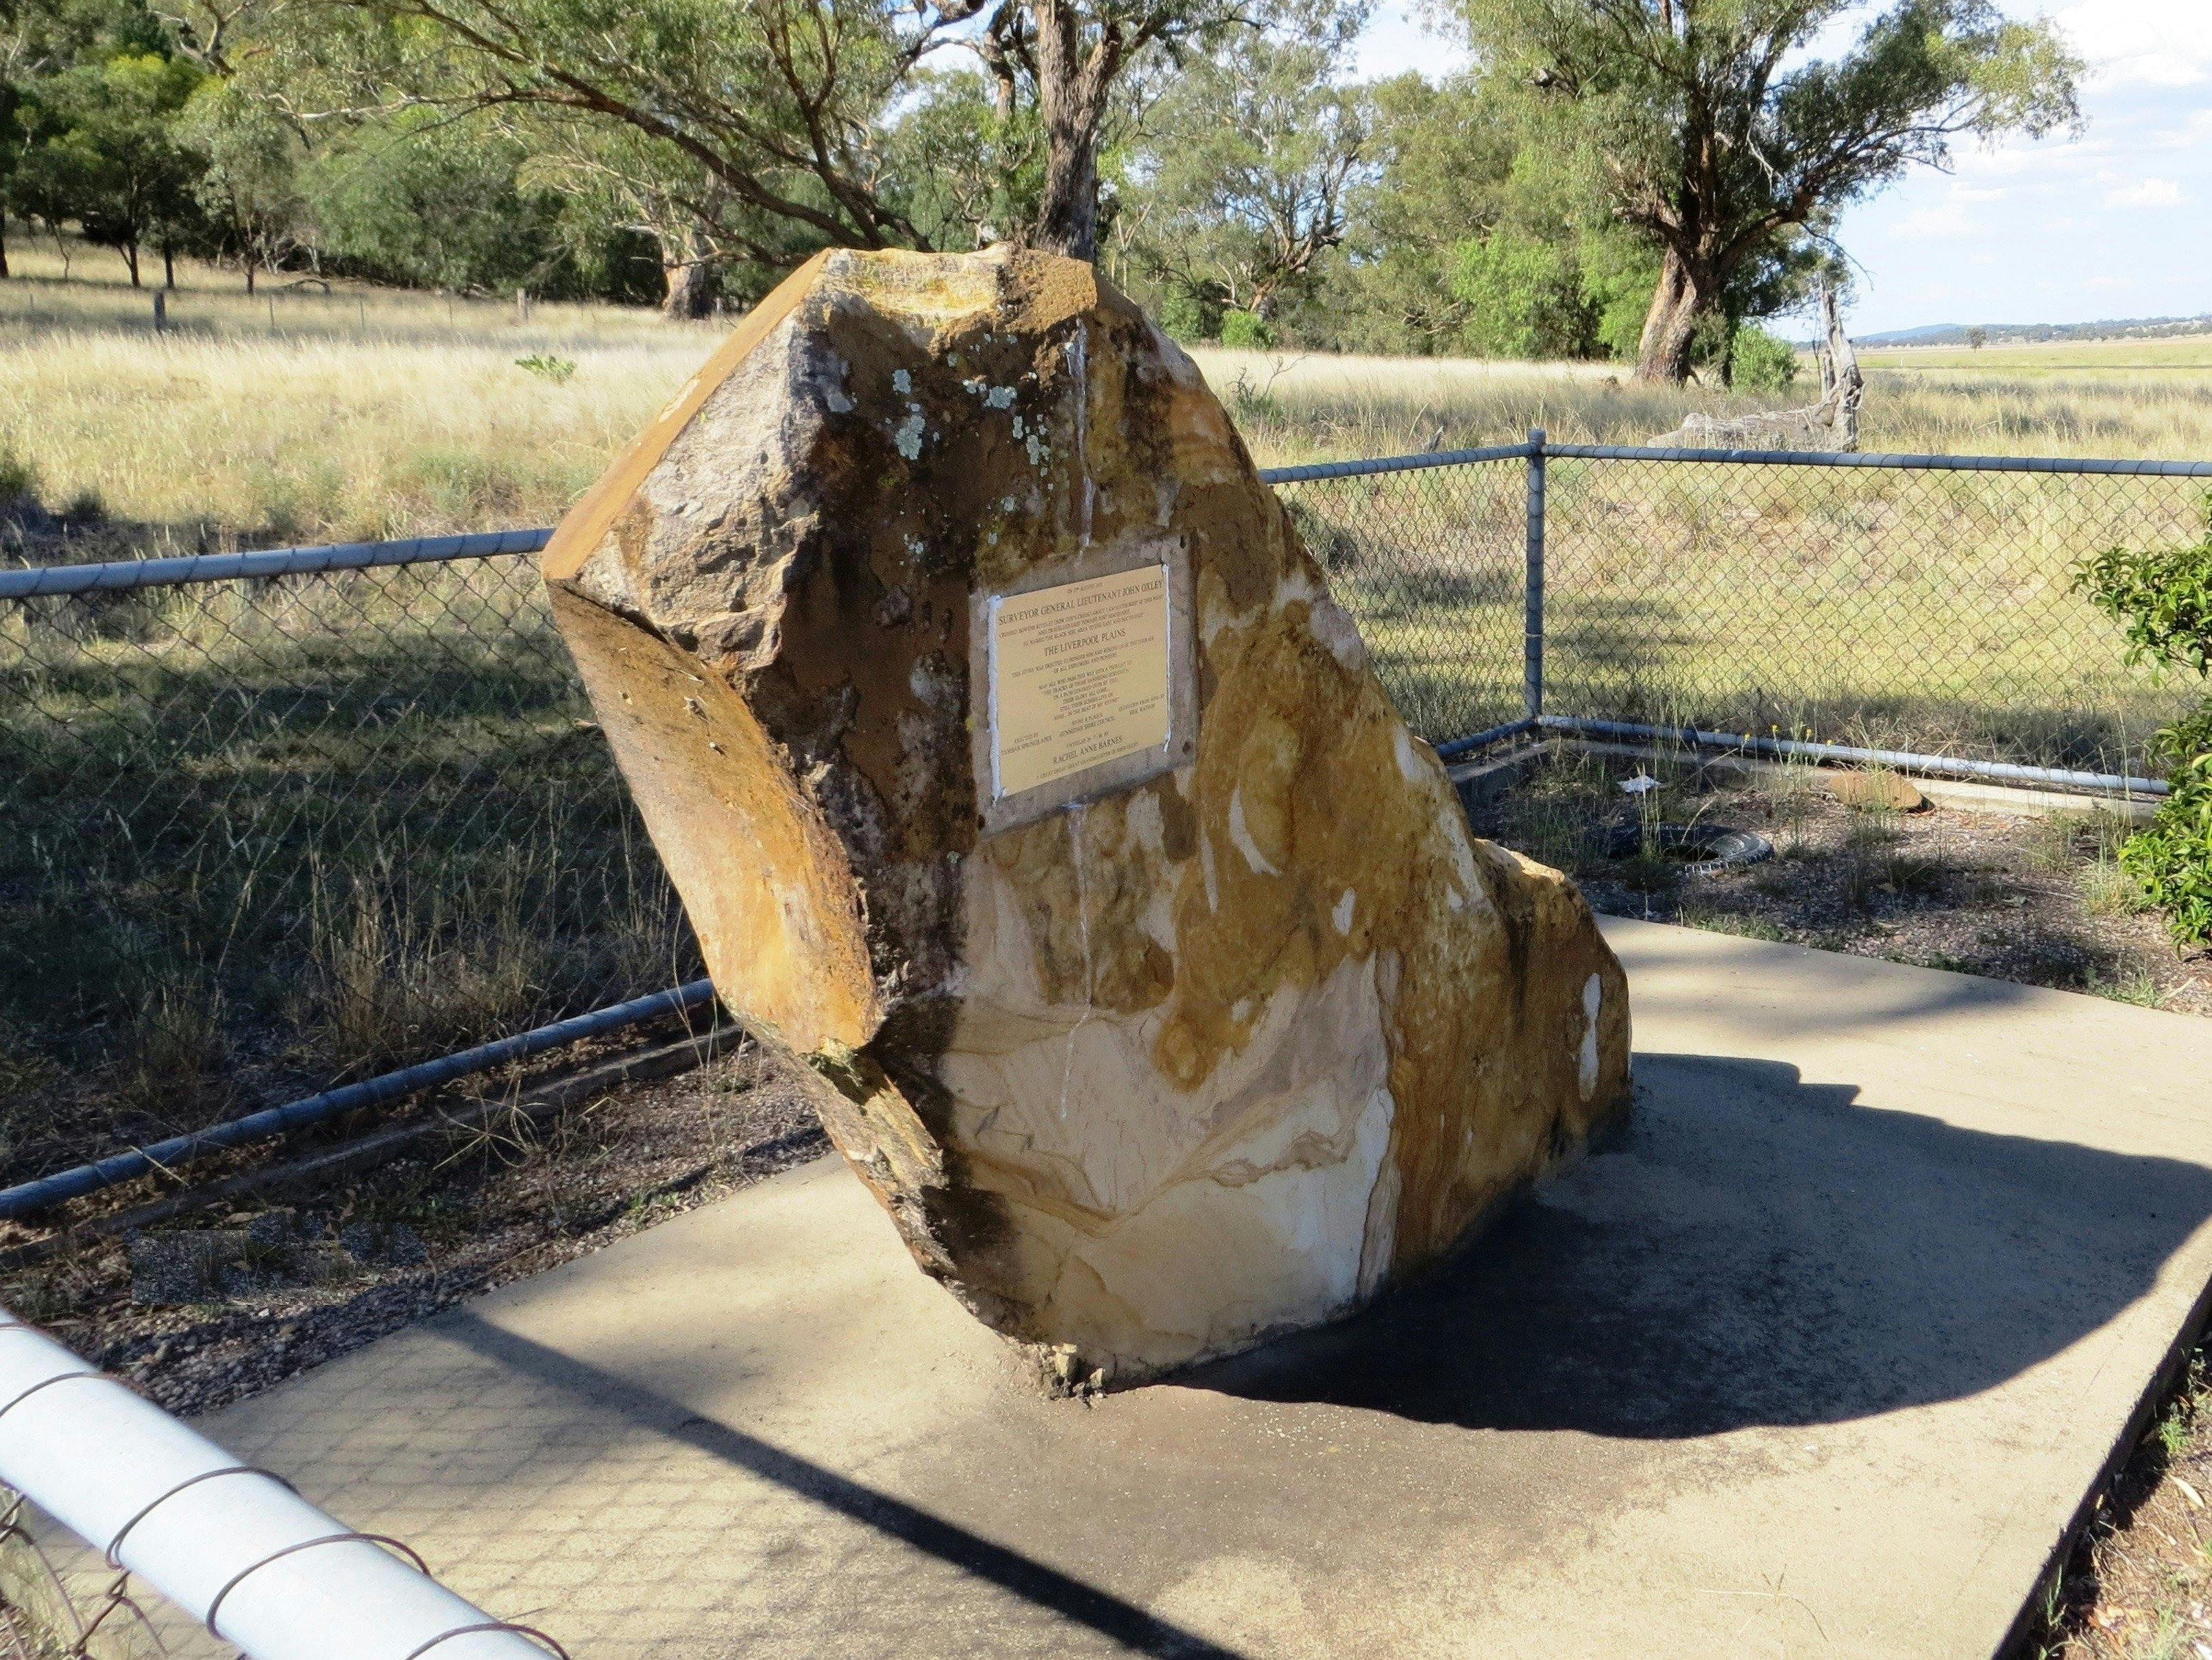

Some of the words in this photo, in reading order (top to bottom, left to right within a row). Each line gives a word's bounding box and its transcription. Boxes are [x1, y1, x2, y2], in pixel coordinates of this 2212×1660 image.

[999, 608, 1038, 625] SURVEYOR
[1041, 599, 1074, 616] GENERAL
[1078, 588, 1121, 608] LIEUTENANT
[1122, 584, 1139, 597] JOHN
[1141, 579, 1163, 592] OXLEY
[1044, 645, 1058, 657] THE
[1060, 634, 1099, 653] LIVERPOOL
[1102, 628, 1126, 642] PLAINS
[1053, 749, 1078, 765] RACHEL
[1080, 743, 1097, 756] ANNE
[1099, 735, 1123, 749] BARNES
